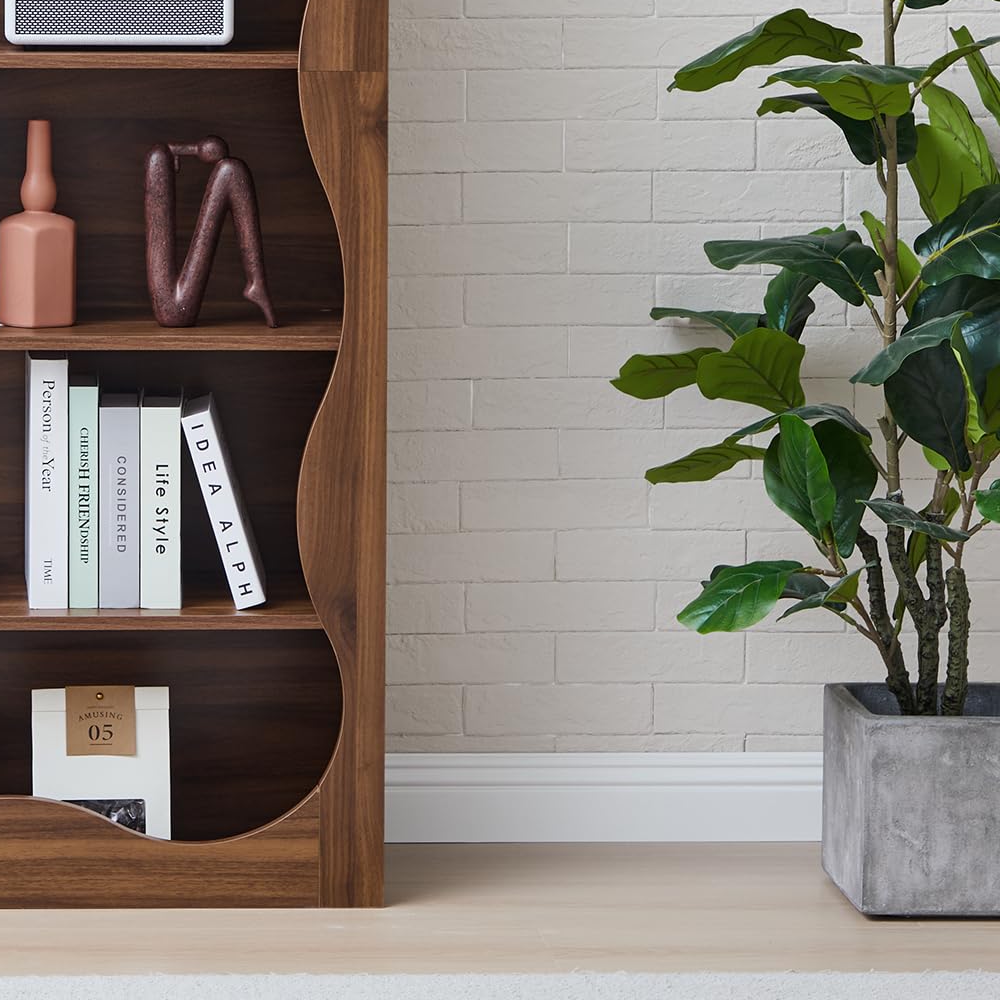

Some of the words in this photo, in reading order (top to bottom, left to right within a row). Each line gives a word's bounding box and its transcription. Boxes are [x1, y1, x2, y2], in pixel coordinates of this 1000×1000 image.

[42, 379, 56, 433] Person
[41, 434, 50, 443] of
[42, 446, 50, 460] the
[78, 427, 90, 479] CHERISH
[42, 457, 55, 492] Year
[155, 464, 169, 497] Life
[116, 456, 127, 553] CONSIDERED
[191, 423, 223, 496] IDEA
[219, 520, 253, 596] ALPH
[78, 484, 90, 564] FRIENDSHIP
[153, 507, 169, 554] Style
[43, 559, 52, 584] TIME
[78, 711, 123, 722] AMUSING
[88, 724, 113, 741] 05
